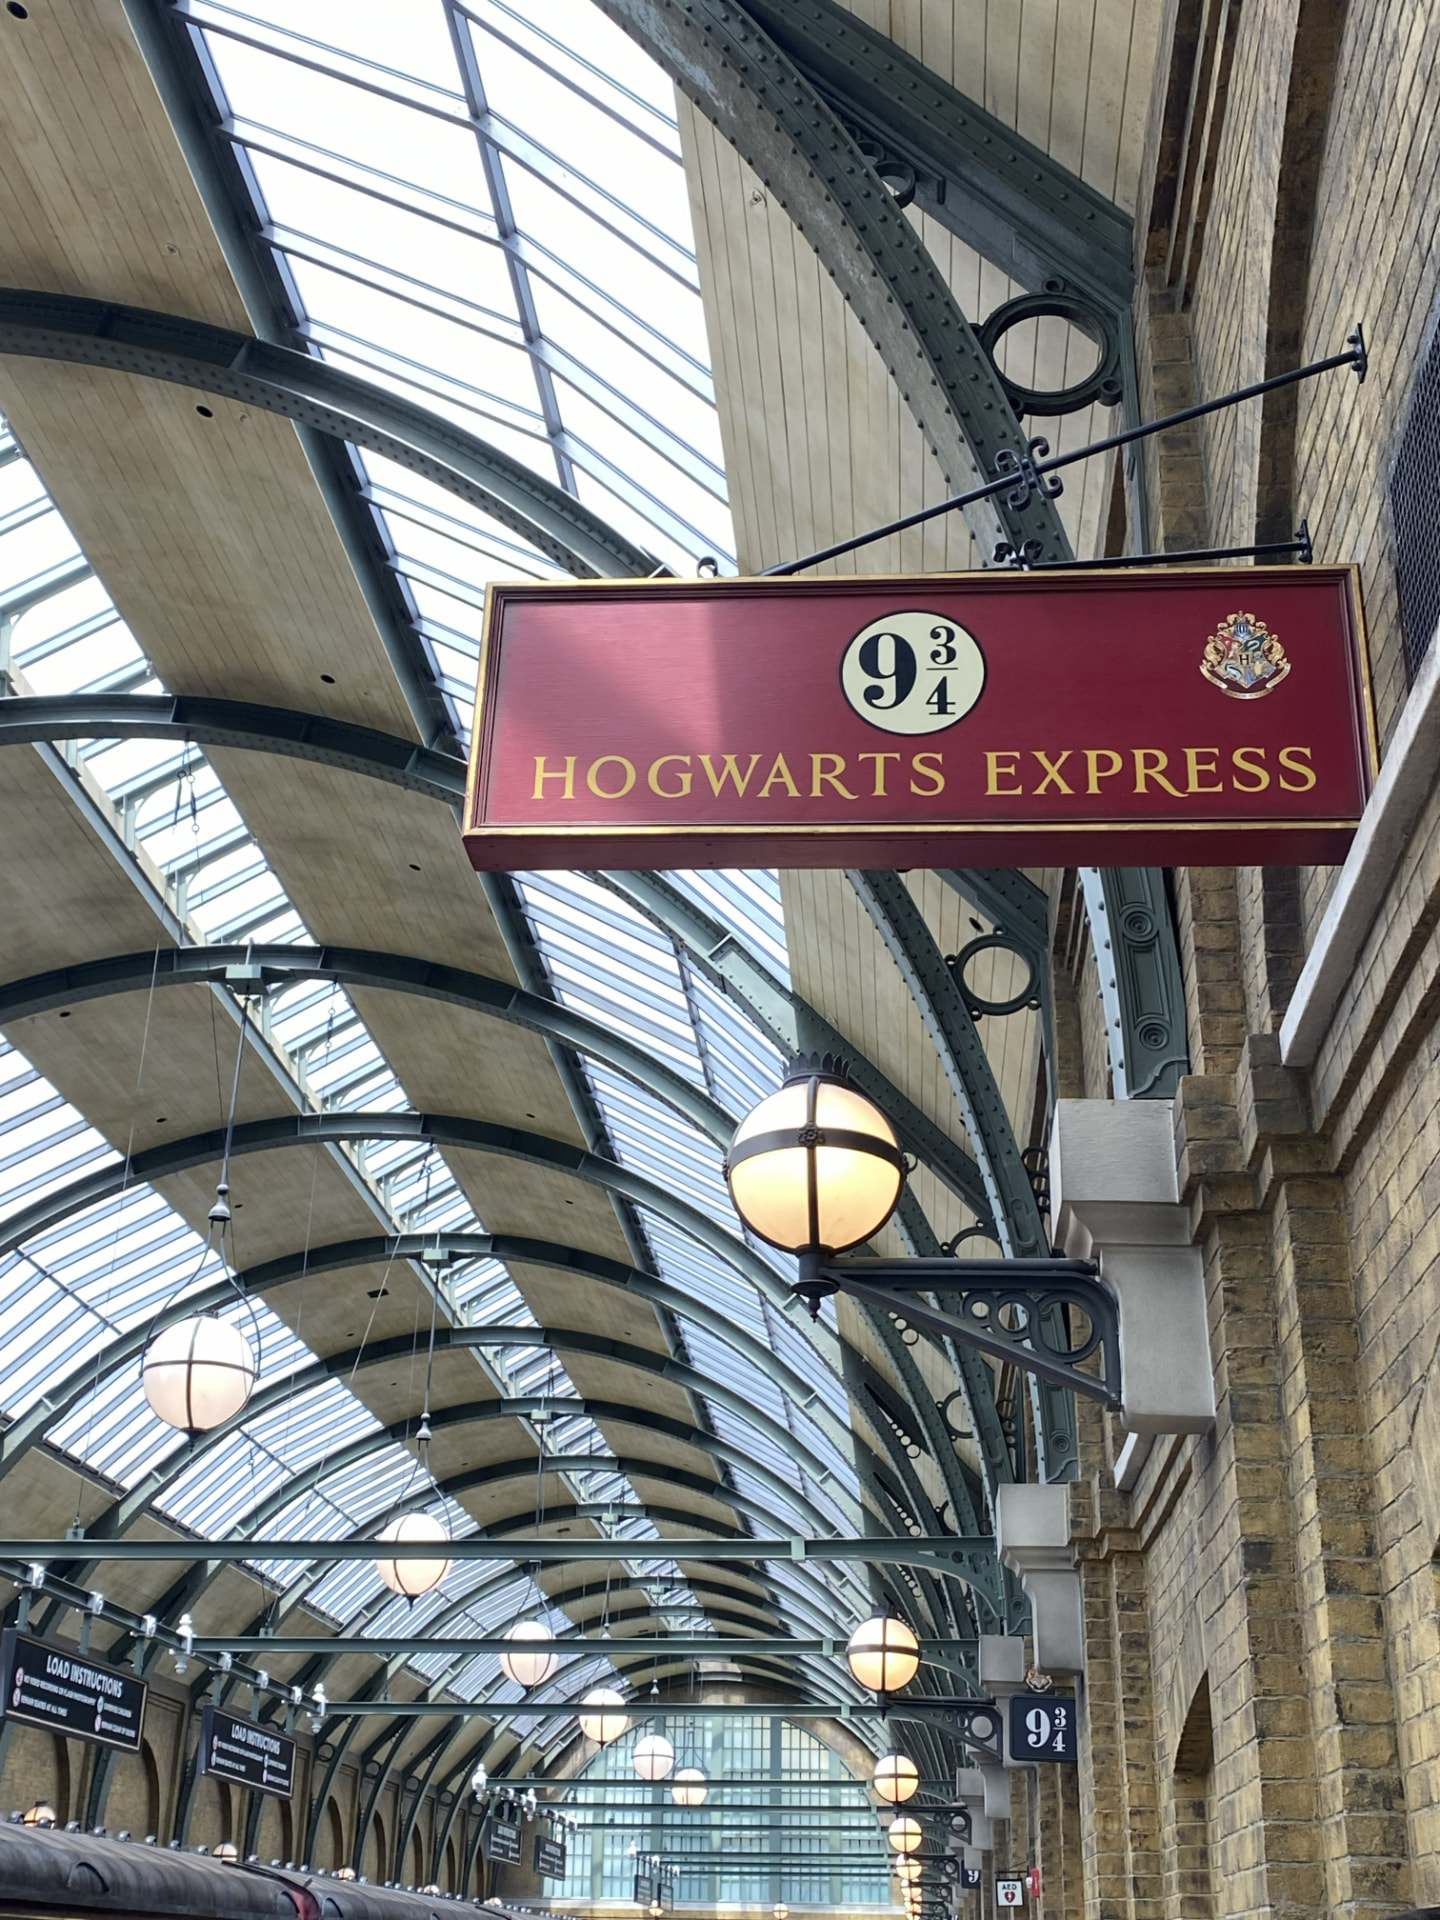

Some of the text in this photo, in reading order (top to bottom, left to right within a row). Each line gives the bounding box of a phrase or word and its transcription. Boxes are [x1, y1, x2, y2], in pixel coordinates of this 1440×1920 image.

[1239, 654, 1250, 666] H
[531, 746, 1317, 800] HOGWARTS EXPRESS
[46, 1654, 70, 1679] LOAD
[70, 1663, 123, 1698] INSTRUCTIONS
[231, 1723, 247, 1742] LOAD
